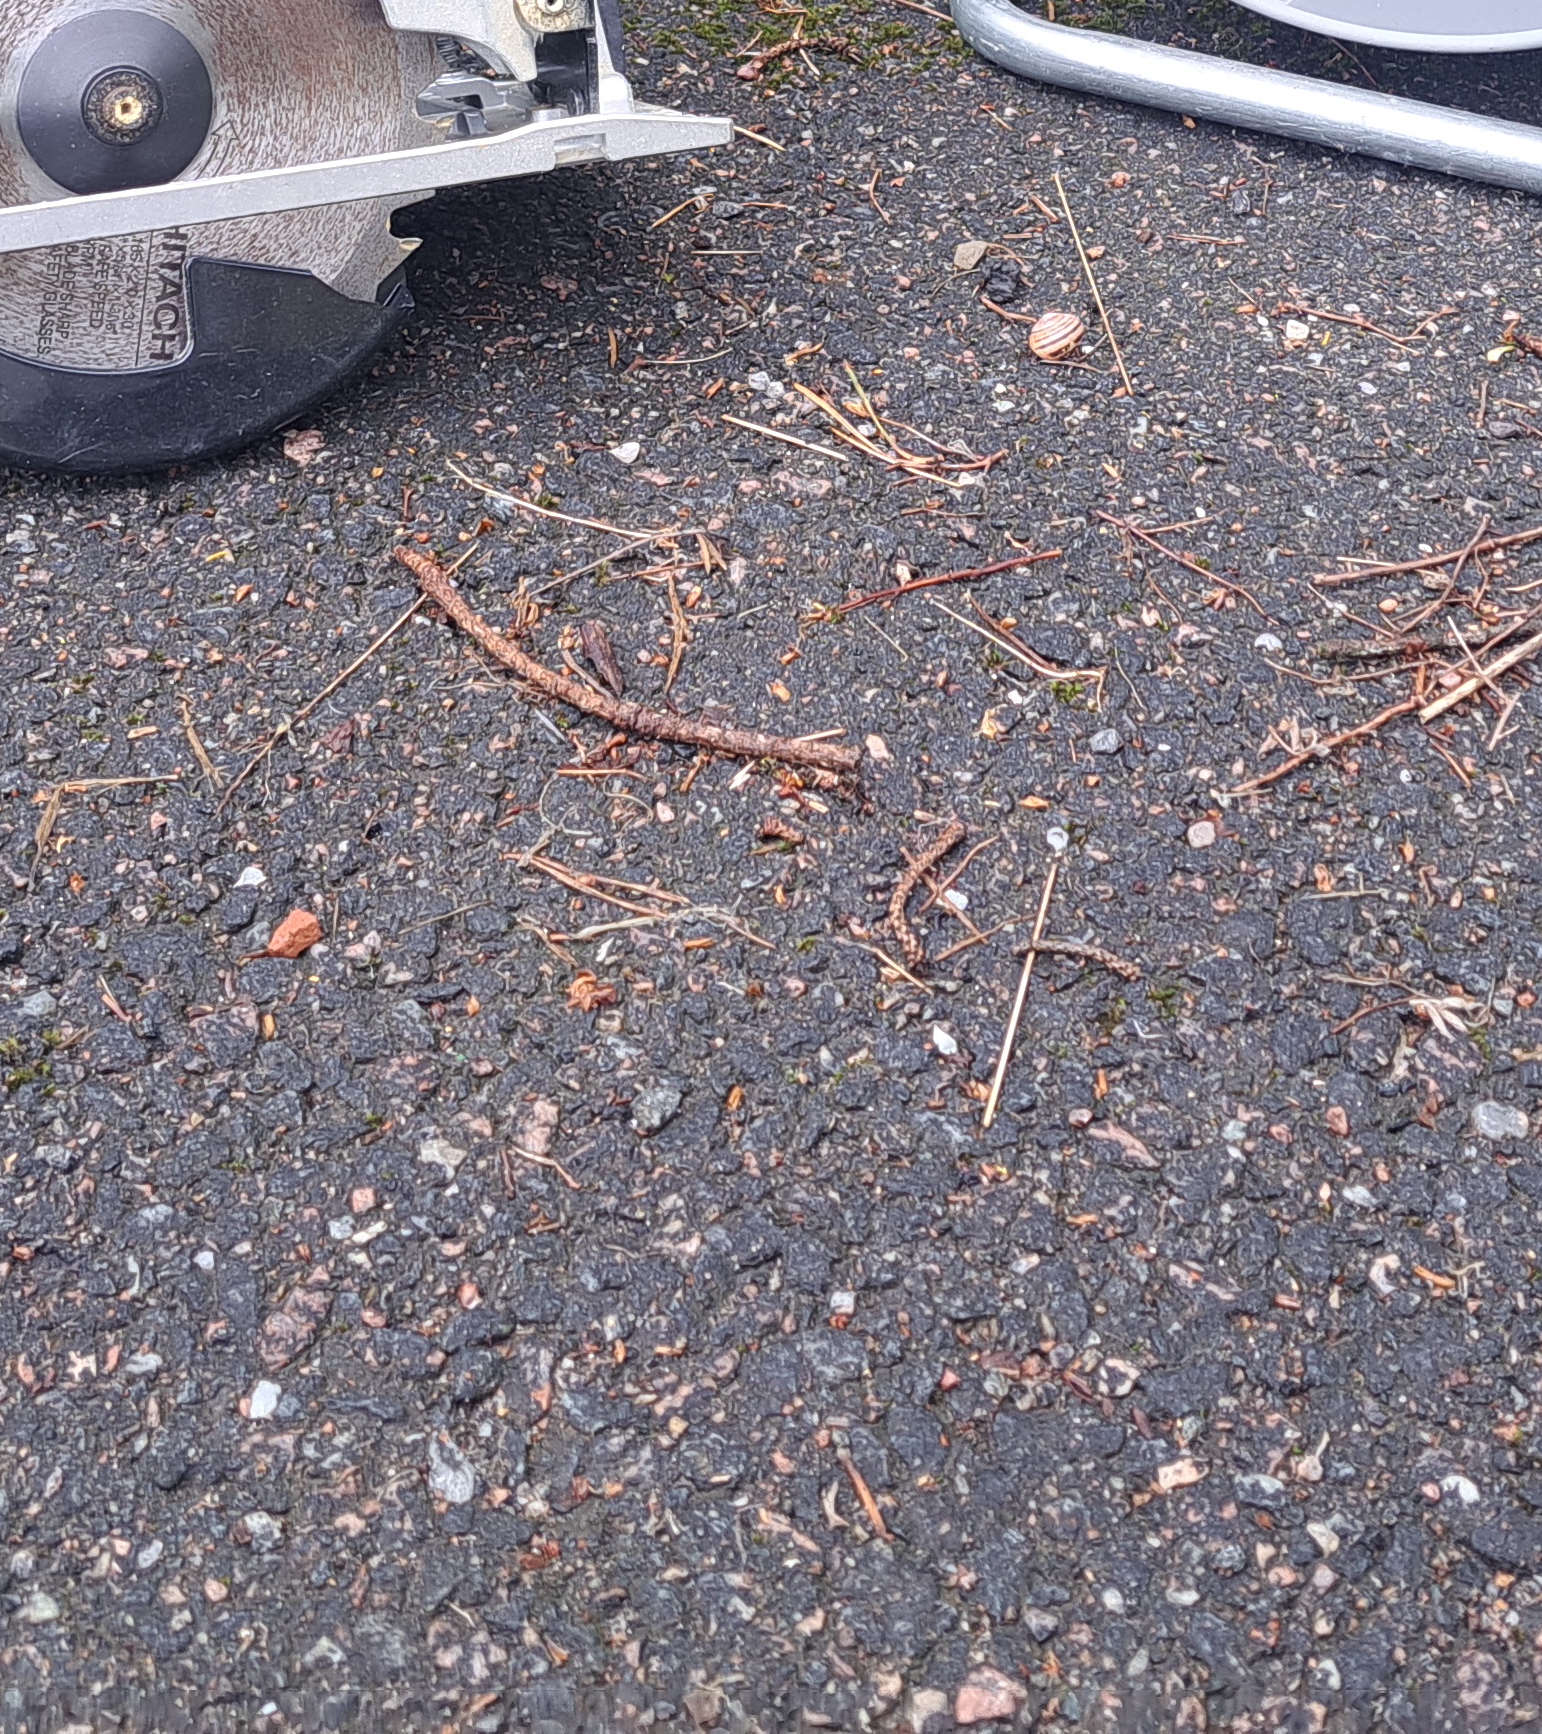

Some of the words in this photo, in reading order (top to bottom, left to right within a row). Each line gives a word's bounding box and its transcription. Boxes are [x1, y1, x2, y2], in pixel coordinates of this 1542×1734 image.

[44, 245, 63, 289] AFETY
[60, 244, 80, 290] BLADE
[57, 292, 75, 340] SHARP
[89, 282, 109, 329] SPEED
[149, 227, 188, 361] HITACH
[37, 292, 58, 355] GLASSES
